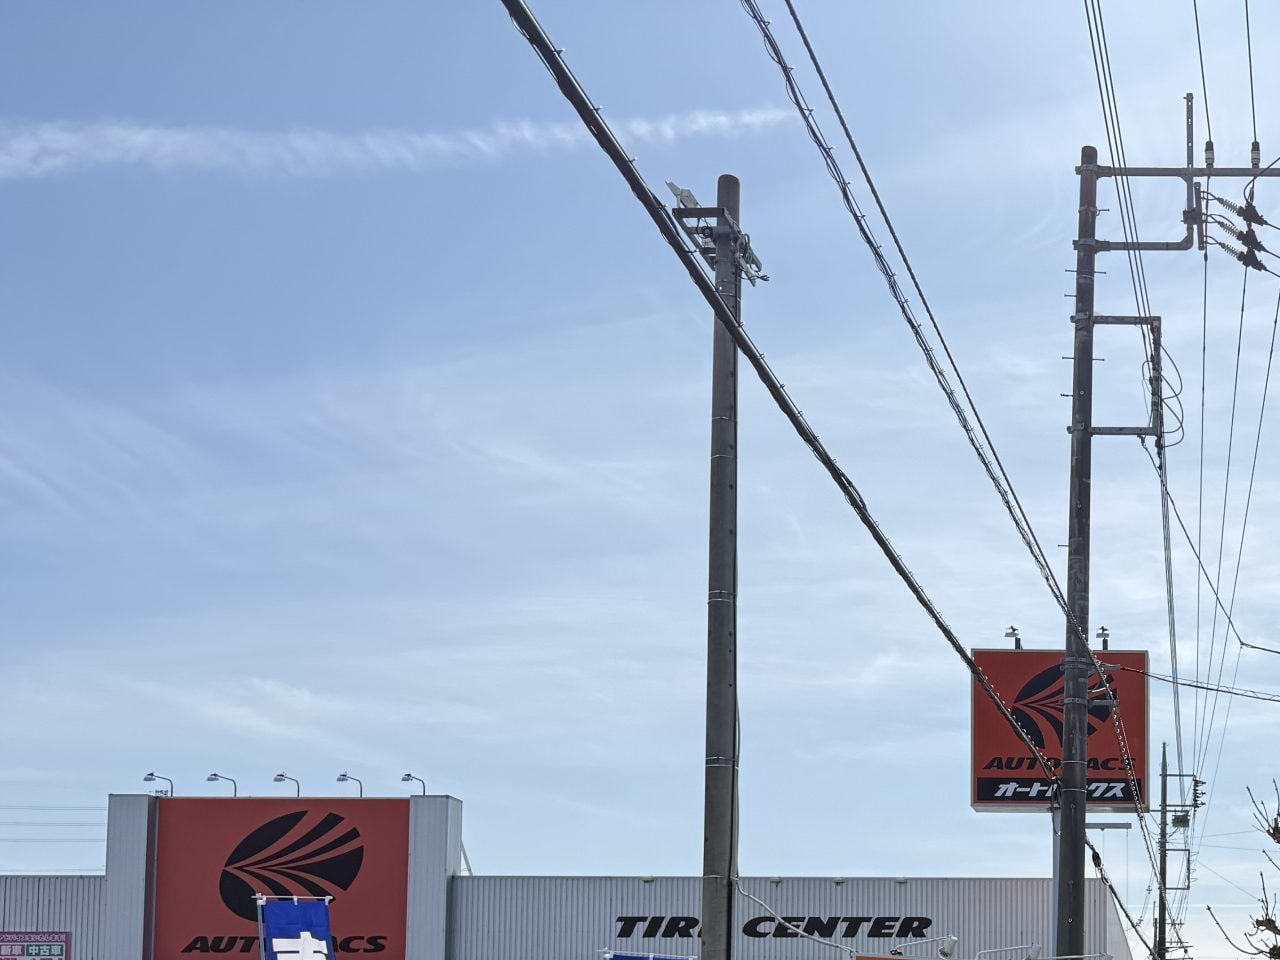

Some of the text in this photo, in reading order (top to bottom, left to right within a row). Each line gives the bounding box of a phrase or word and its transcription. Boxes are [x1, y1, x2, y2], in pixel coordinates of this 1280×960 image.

[984, 757, 1136, 771] AUTOACS
[994, 782, 1127, 798] オートクス
[616, 916, 933, 938] TIR CENTER
[28, 945, 62, 955] 中古車
